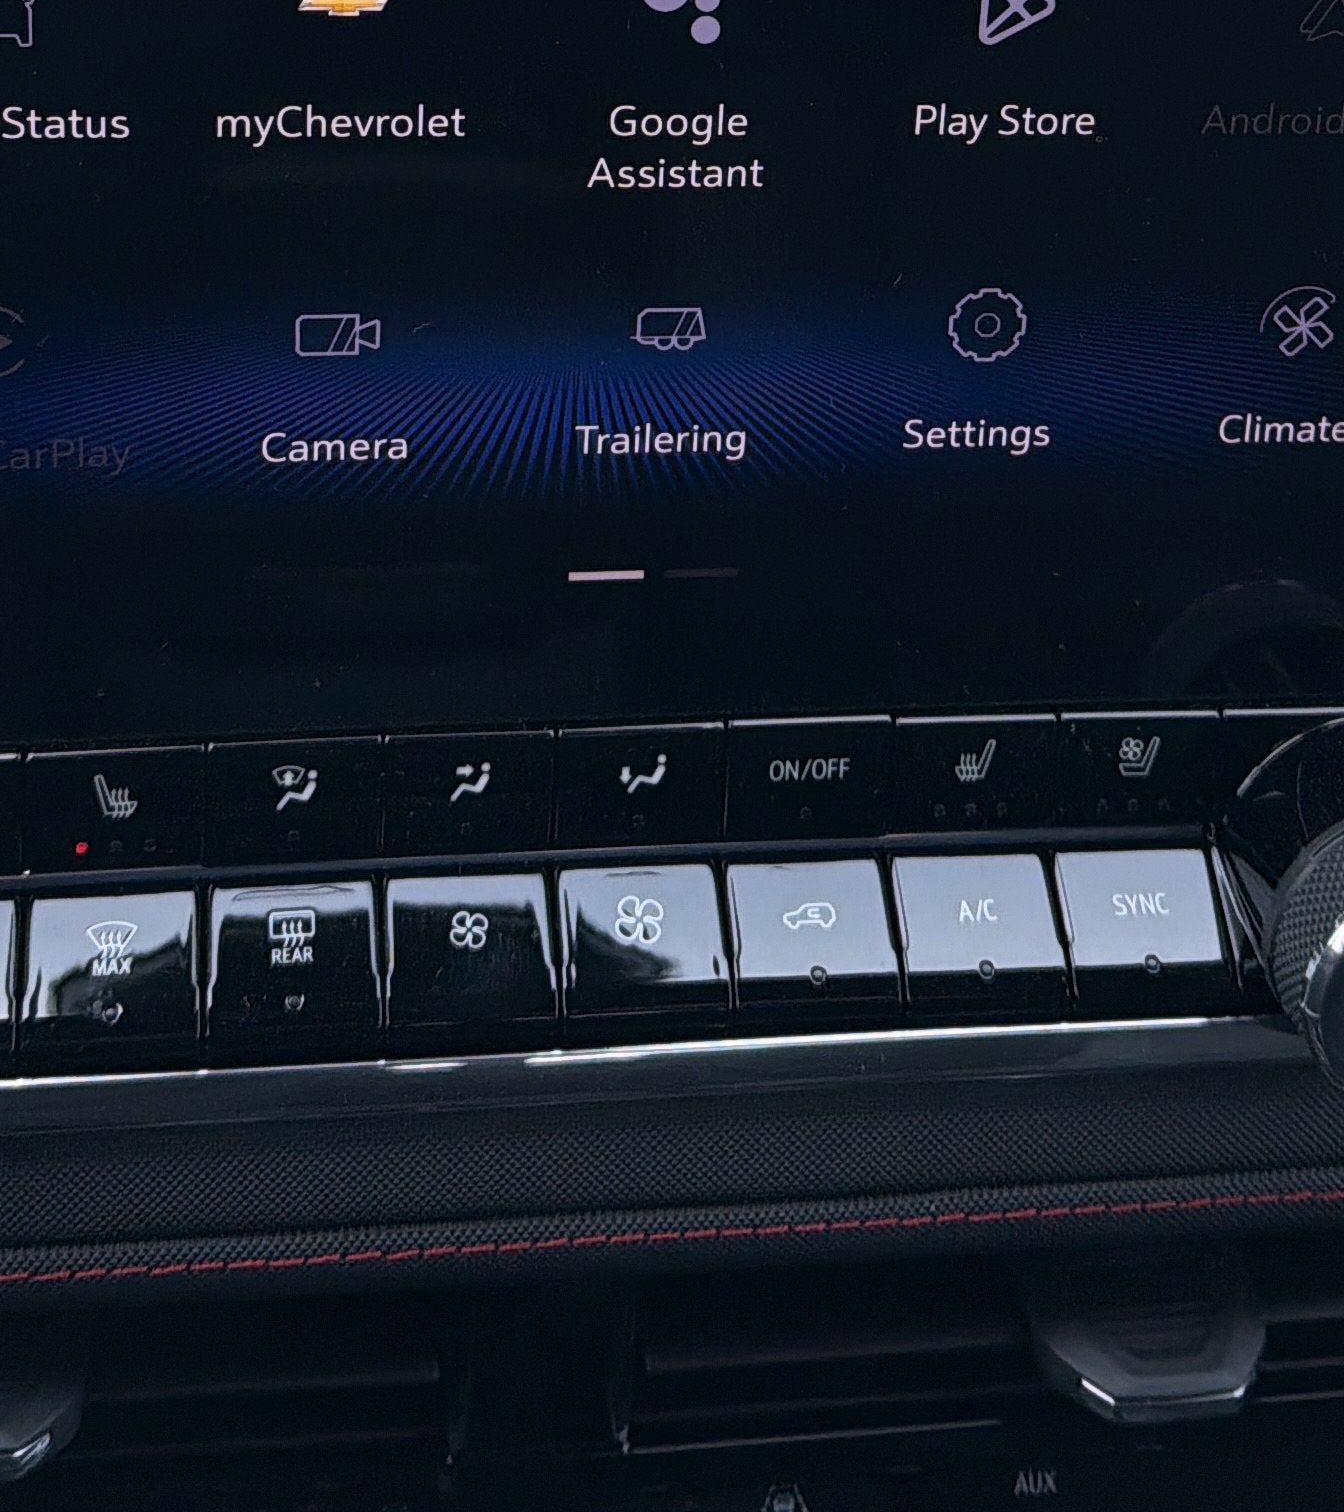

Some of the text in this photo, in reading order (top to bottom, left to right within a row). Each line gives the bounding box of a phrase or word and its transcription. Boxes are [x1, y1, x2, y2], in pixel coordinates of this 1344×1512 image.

[1, 105, 131, 141] Status
[215, 103, 466, 148] myChevrolet
[609, 103, 749, 147] Google
[913, 101, 1097, 146] Play Store
[587, 157, 765, 189] Assistant
[260, 431, 410, 465] Camera
[575, 422, 747, 462] Trailering
[902, 418, 1051, 457] Settings
[768, 756, 851, 783] ON/OFF
[958, 898, 999, 924] A/C
[1112, 891, 1170, 918] SYNC
[91, 956, 133, 977] MAX
[270, 945, 314, 965] REAR
[1013, 1468, 1057, 1497] AUX
